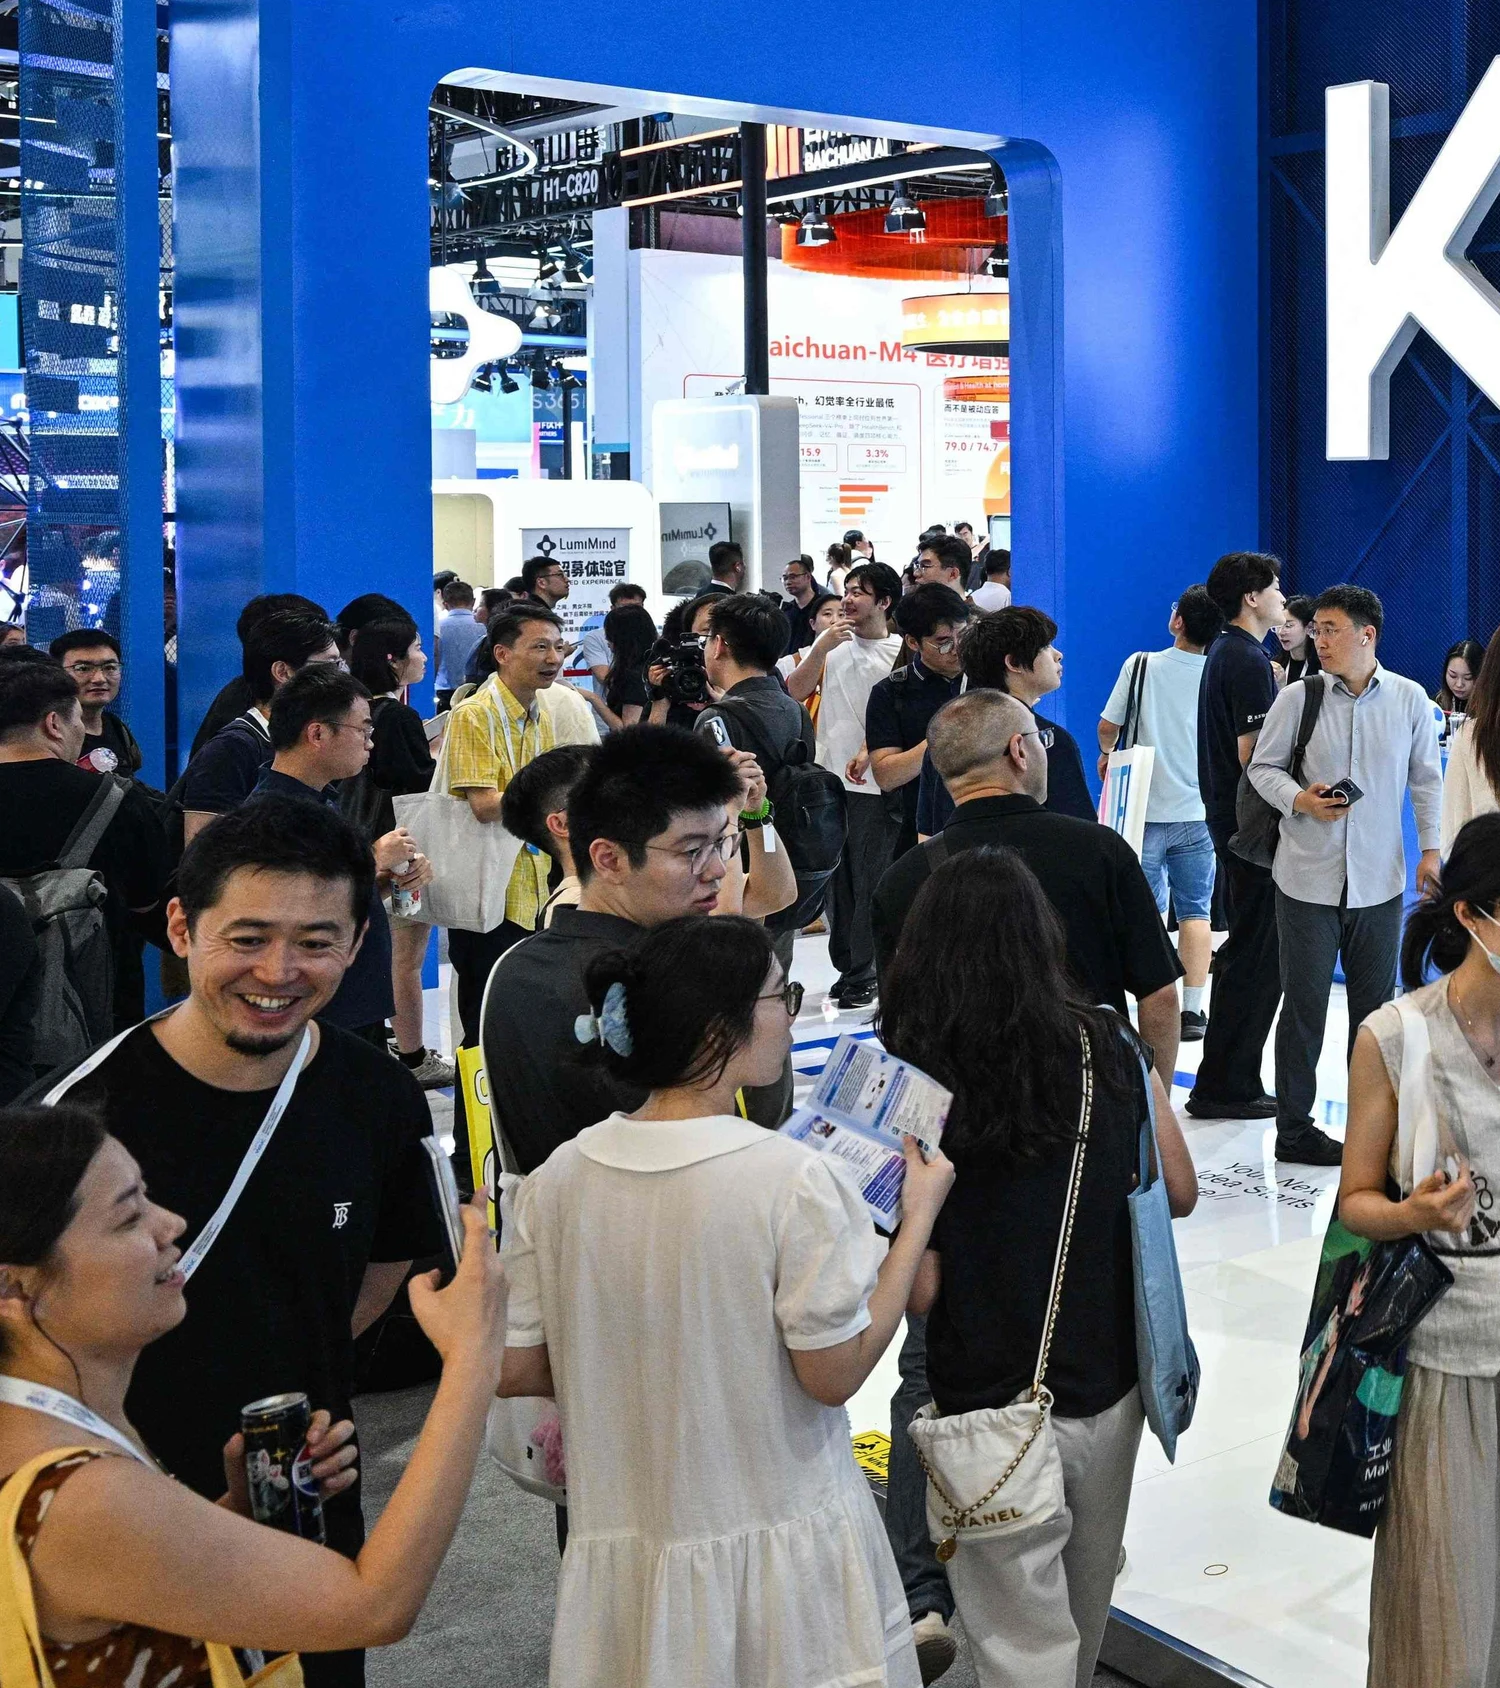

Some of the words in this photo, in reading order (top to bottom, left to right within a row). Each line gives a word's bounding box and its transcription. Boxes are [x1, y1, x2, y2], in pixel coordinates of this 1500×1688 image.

[543, 169, 599, 202] H1-C820
[769, 335, 918, 363] aichuan-M4
[865, 449, 889, 458] 3.3%
[1276, 1177, 1326, 1196] Nex
[941, 1507, 1023, 1528] CHANEL
